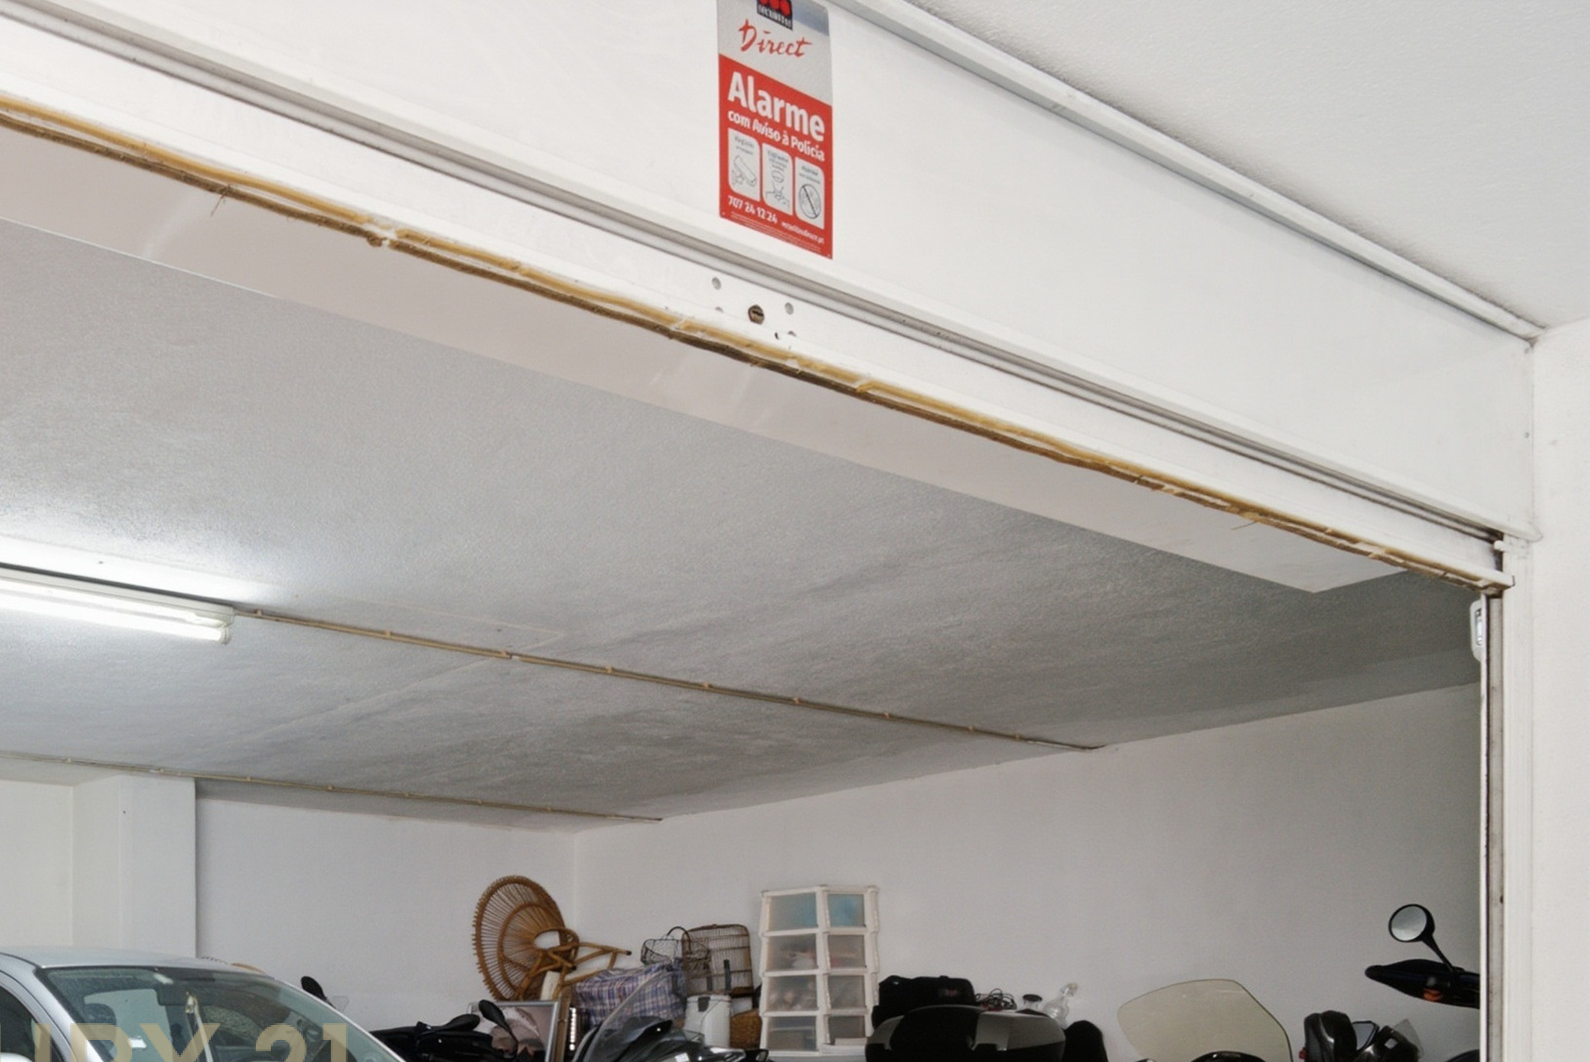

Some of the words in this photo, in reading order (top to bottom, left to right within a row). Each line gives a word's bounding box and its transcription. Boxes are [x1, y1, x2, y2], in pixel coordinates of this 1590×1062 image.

[738, 18, 812, 57] Direct
[728, 71, 825, 142] Alarme
[728, 110, 750, 128] com
[752, 118, 781, 142] Aviso
[782, 130, 790, 146] à
[791, 135, 825, 162] Polícia
